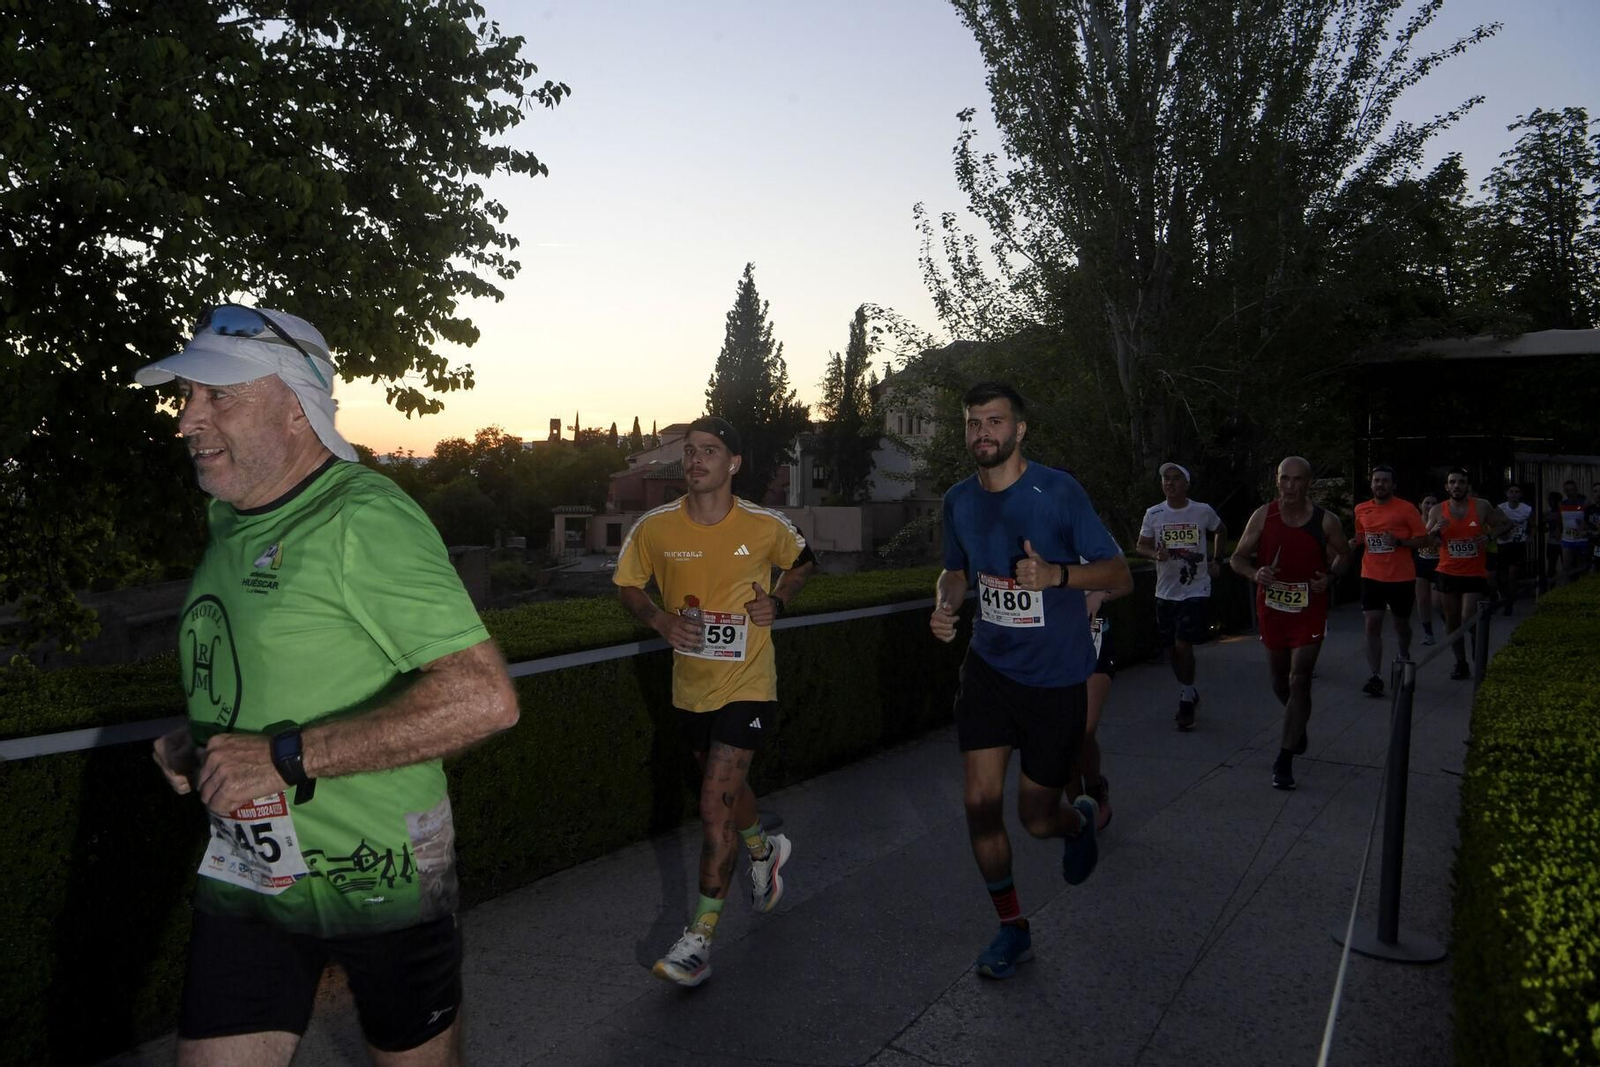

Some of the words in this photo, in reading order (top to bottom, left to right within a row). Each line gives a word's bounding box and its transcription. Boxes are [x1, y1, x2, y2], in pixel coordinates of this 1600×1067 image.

[1164, 530, 1194, 541] 5305
[1449, 543, 1474, 552] 1059
[242, 578, 279, 590] HUÉSCAR
[982, 587, 1031, 611] 4180
[1267, 588, 1302, 603] 2752
[191, 604, 224, 629] HOTEL
[705, 625, 736, 645] 59
[215, 702, 233, 725] TE
[241, 807, 257, 818] MAYO
[256, 805, 274, 817] 2024
